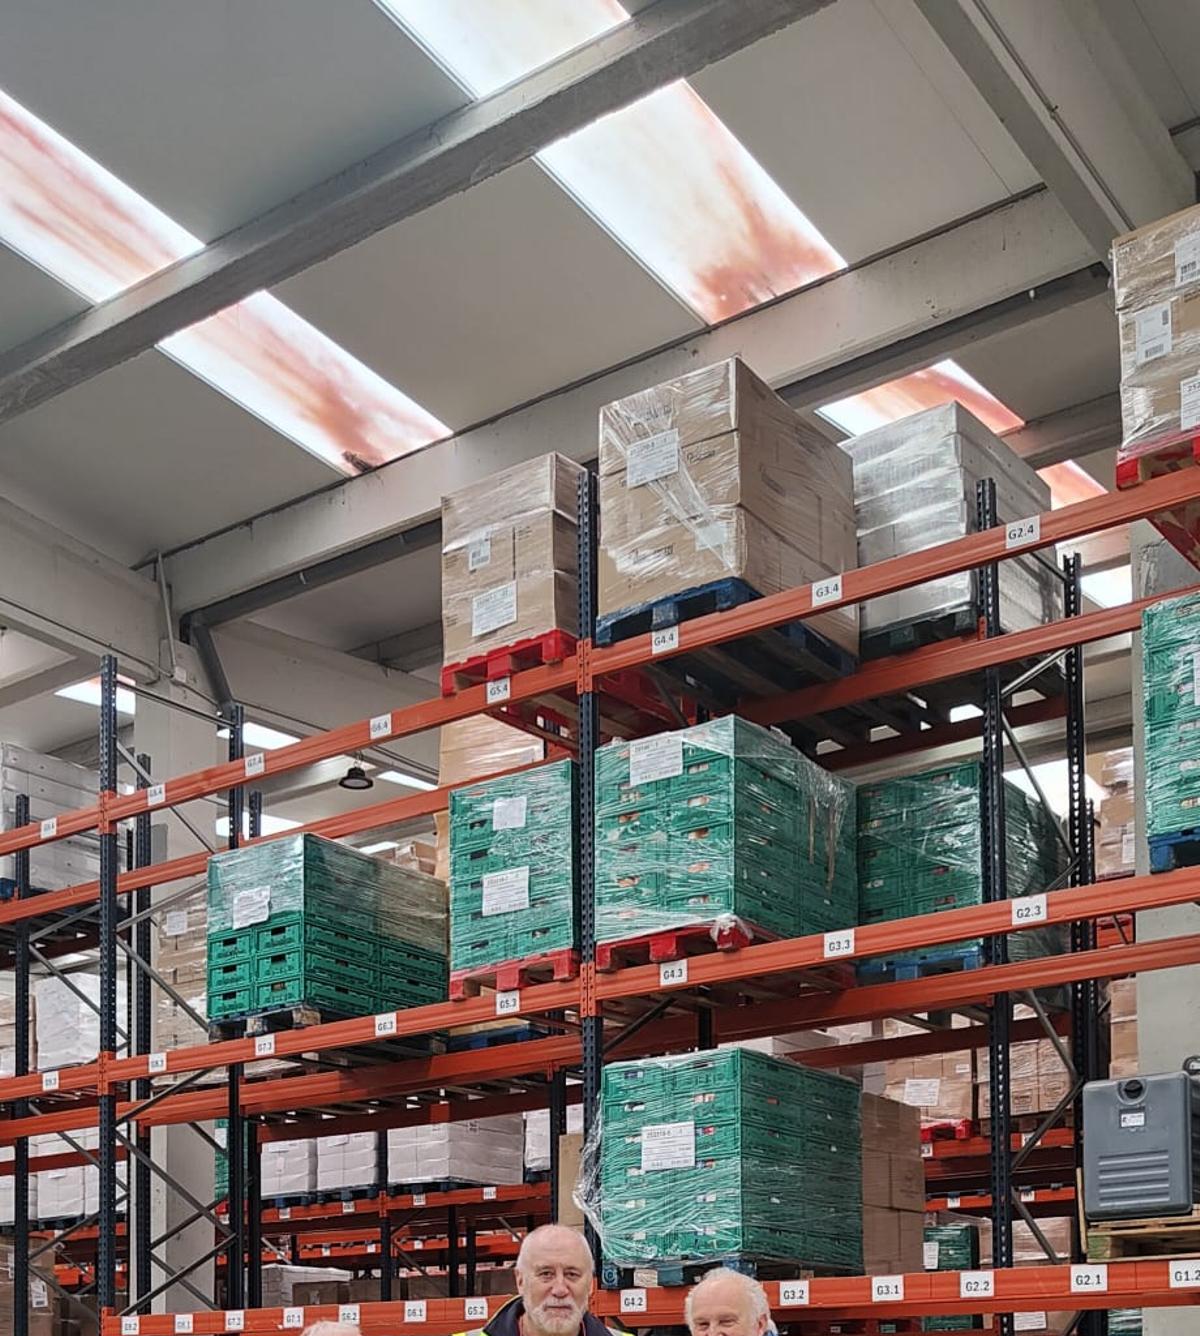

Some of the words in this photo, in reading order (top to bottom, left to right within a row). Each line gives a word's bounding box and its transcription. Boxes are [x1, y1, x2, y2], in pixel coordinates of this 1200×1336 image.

[1008, 524, 1034, 540] G2.4
[816, 583, 839, 598] G3.4
[654, 632, 674, 647] G4.4
[489, 683, 508, 696] G5.4
[1016, 905, 1041, 919] G2.3
[828, 939, 850, 952] G3.3
[663, 968, 683, 980] G4.3
[500, 998, 517, 1009] G5.3
[377, 1021, 393, 1032] G6.3
[1076, 1273, 1101, 1285] G2.1
[1175, 1270, 1200, 1281] G1.2
[876, 1284, 900, 1295] G3.1
[965, 1280, 990, 1292] G2.2
[783, 1289, 804, 1300] G3.2
[624, 1296, 644, 1307] G4.2
[407, 1308, 423, 1318] G6.1
[467, 1306, 485, 1316] G5.2
